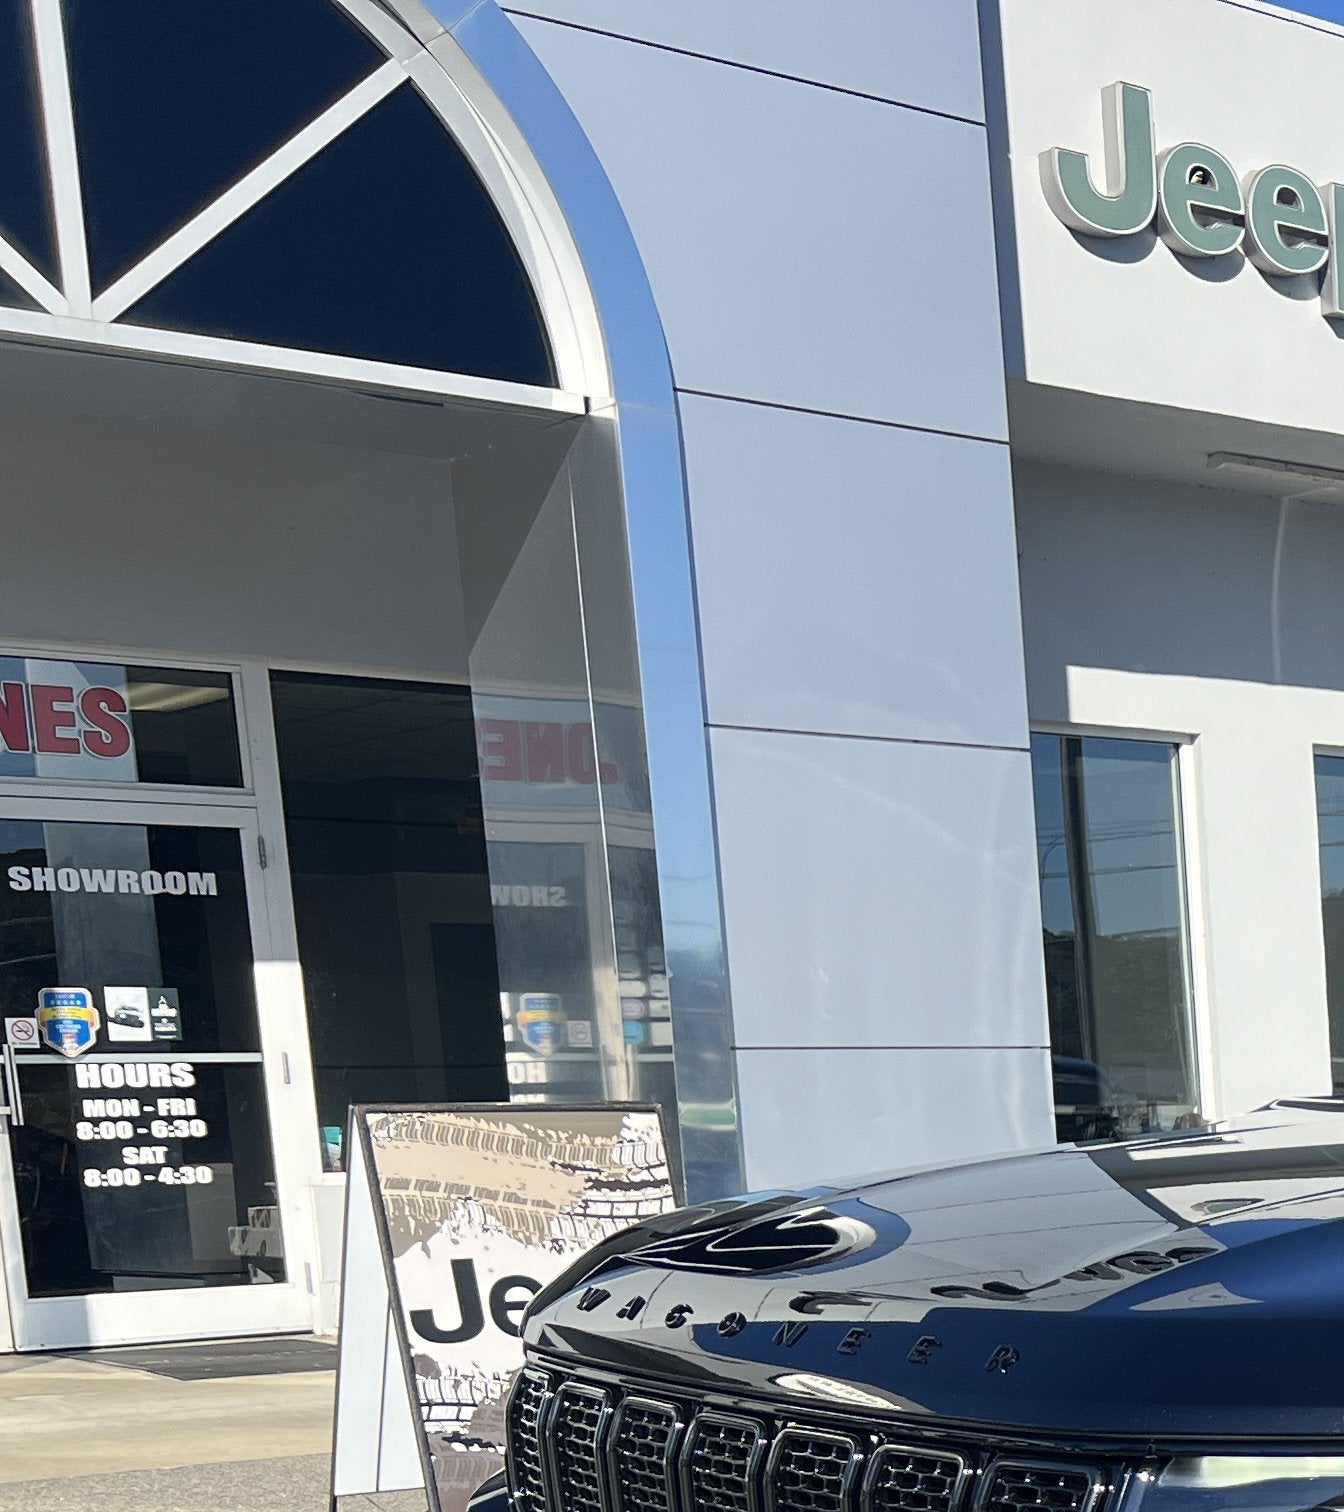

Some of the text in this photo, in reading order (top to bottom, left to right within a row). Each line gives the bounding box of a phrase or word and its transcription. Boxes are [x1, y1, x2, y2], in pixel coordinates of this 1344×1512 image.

[7, 865, 218, 896] SHOWROOM
[75, 1062, 196, 1088] HOURS
[82, 1099, 140, 1117] MON
[157, 1097, 197, 1116] FRI
[76, 1121, 134, 1140] 8:00
[150, 1119, 208, 1138] 6:30
[122, 1146, 168, 1165] SAT
[83, 1168, 142, 1187] 8:00
[158, 1166, 214, 1185] 4:30
[576, 1286, 1022, 1375] WAGONEER
